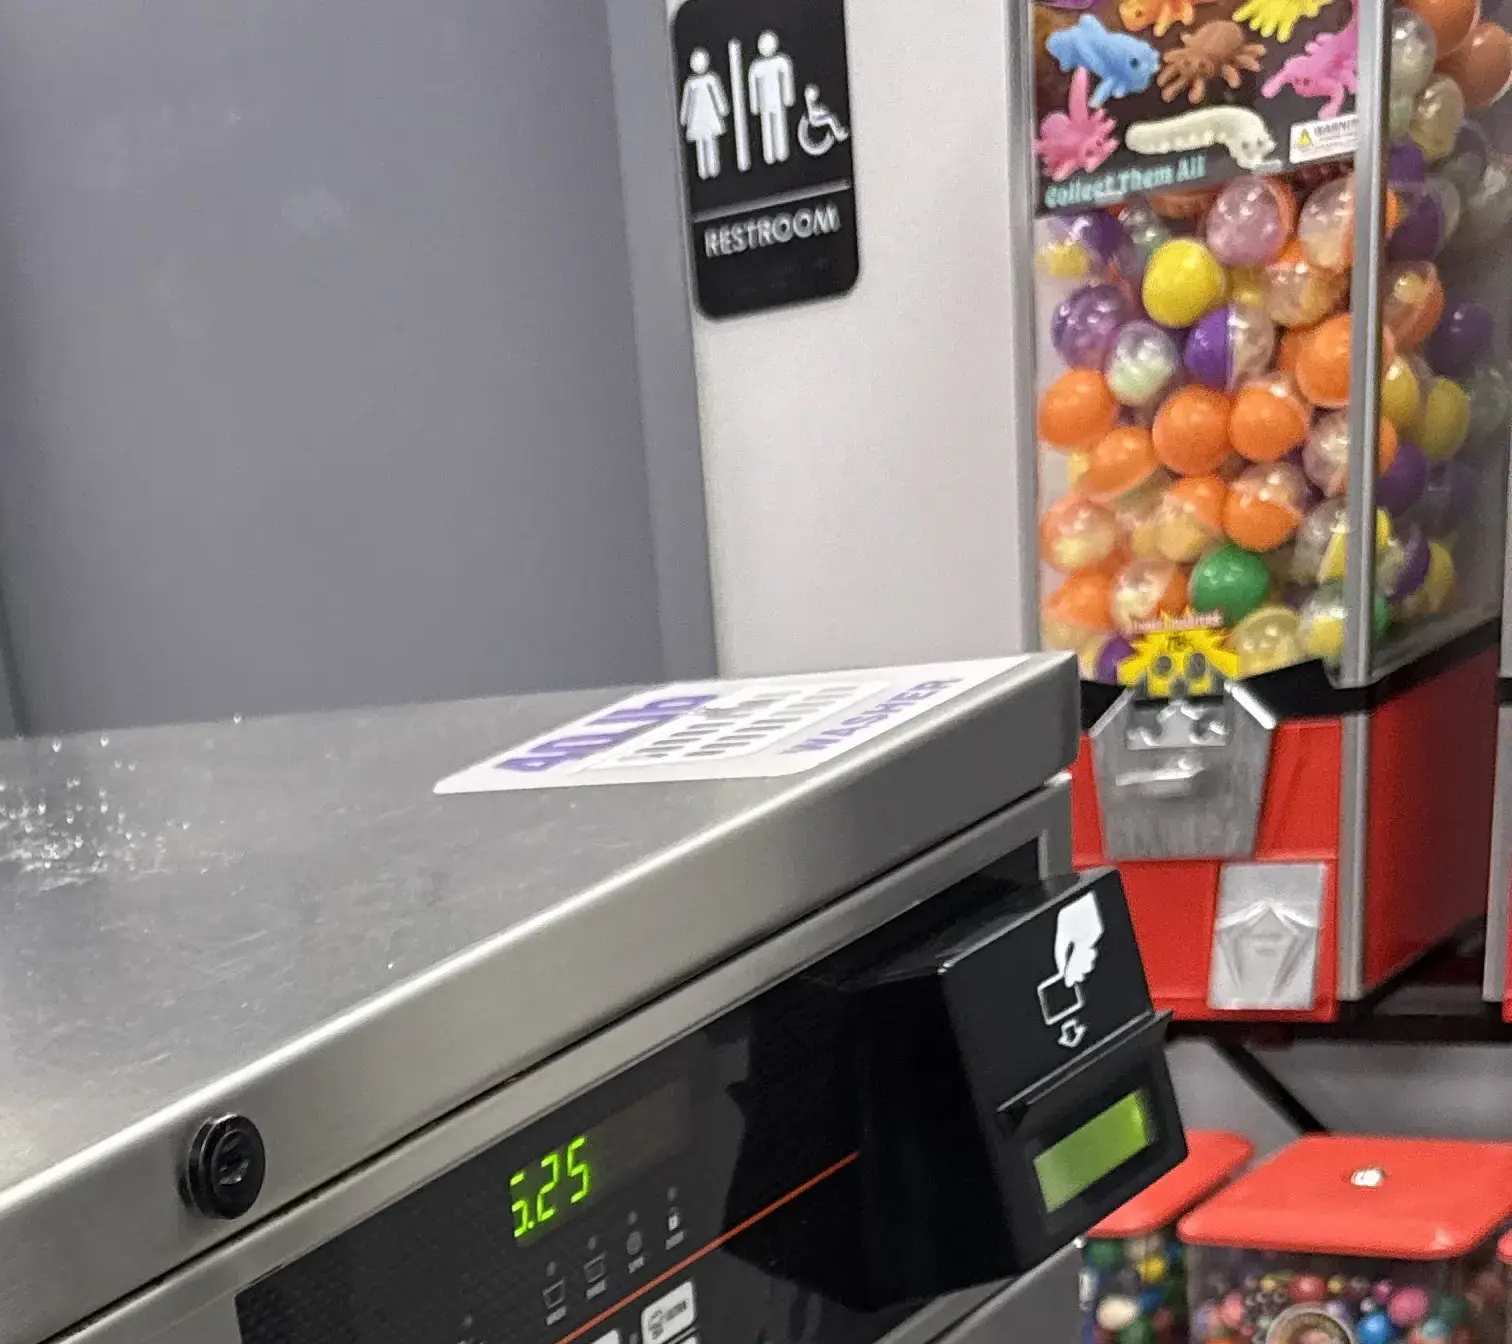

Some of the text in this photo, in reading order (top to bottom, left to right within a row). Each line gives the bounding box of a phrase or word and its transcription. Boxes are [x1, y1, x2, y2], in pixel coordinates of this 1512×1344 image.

[1176, 154, 1207, 183] All
[704, 203, 841, 258] RESTROOM
[779, 678, 964, 755] WASHER
